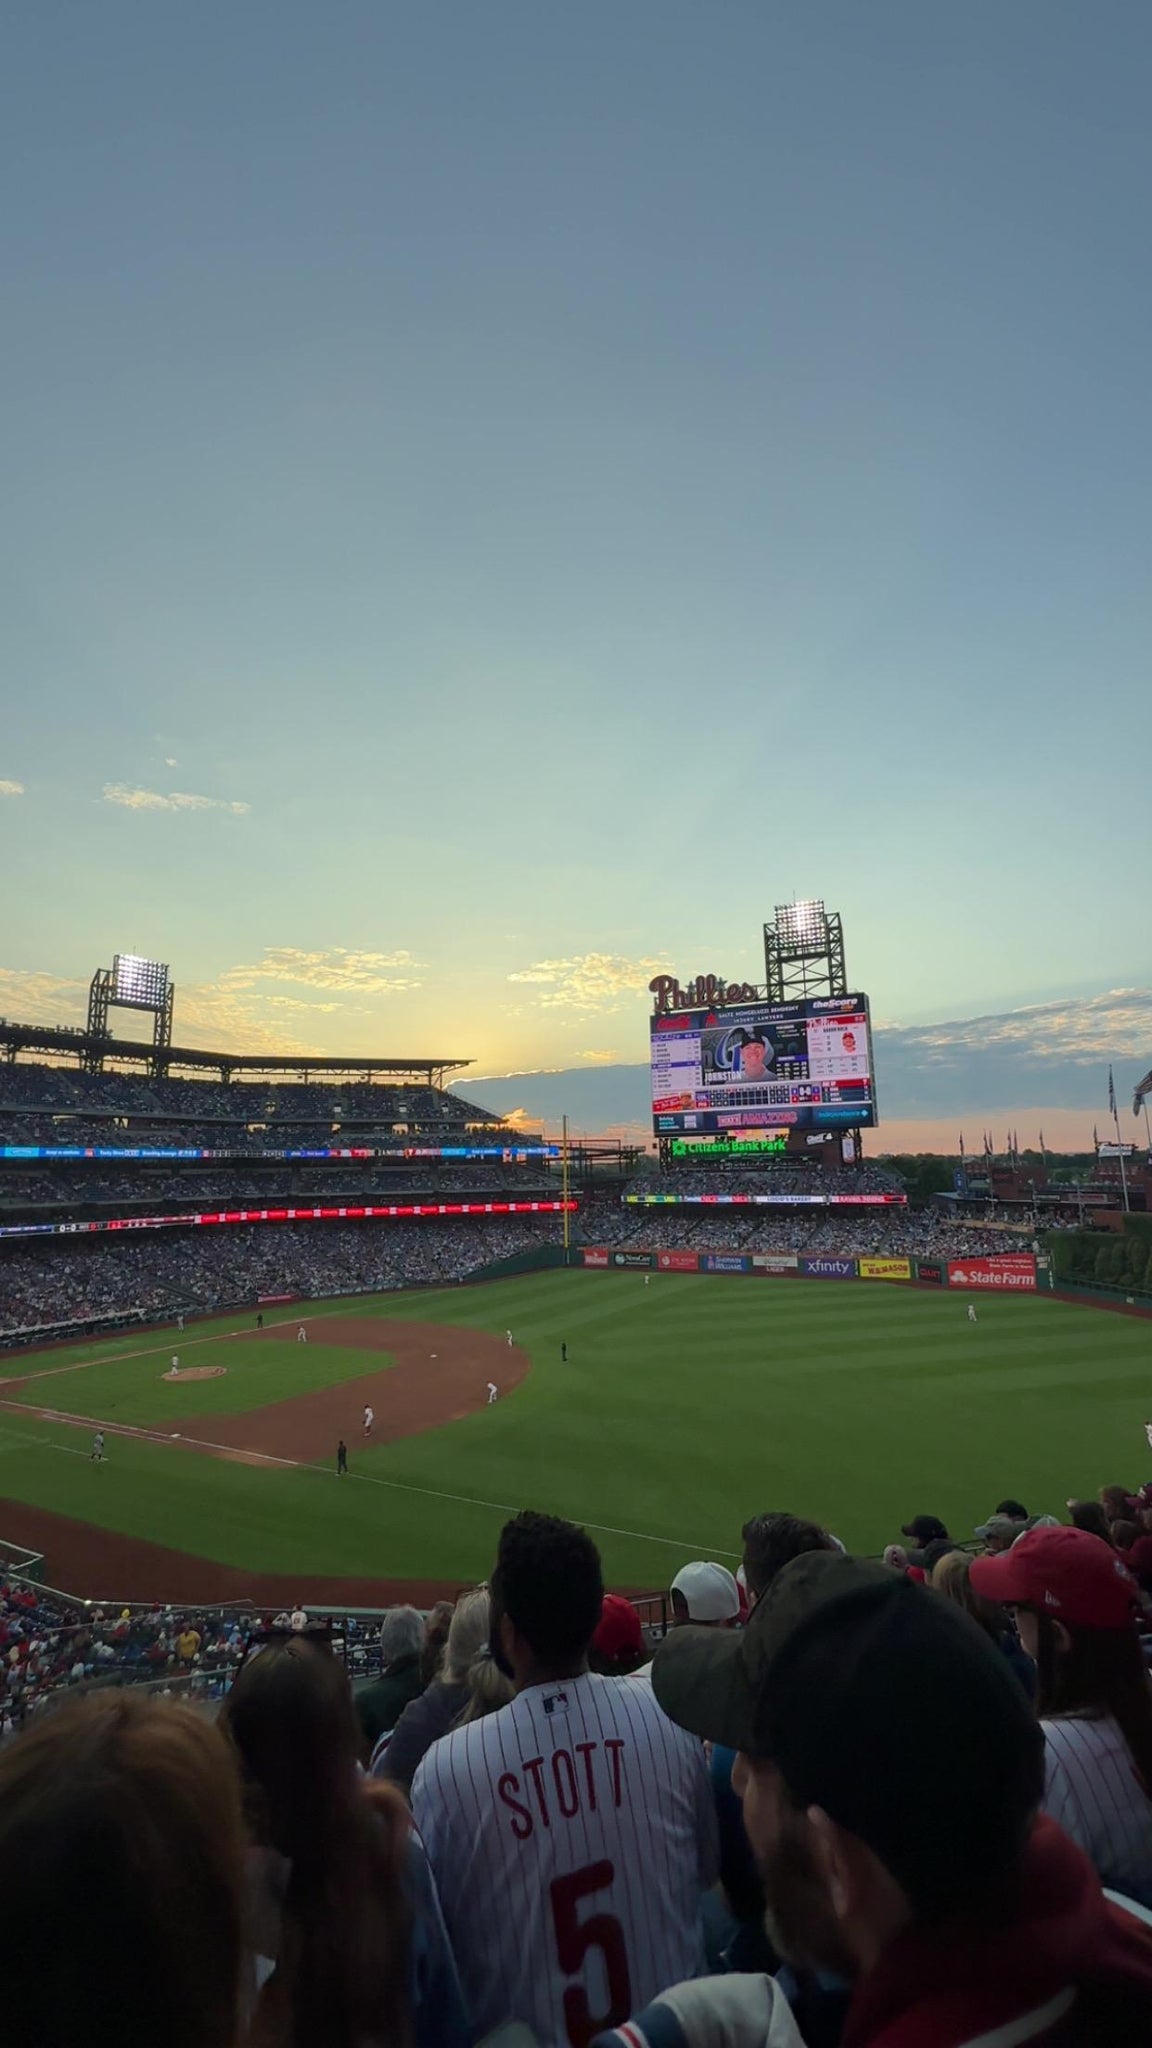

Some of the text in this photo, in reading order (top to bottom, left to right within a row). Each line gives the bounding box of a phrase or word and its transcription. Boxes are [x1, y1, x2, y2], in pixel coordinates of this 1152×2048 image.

[649, 974, 756, 1012] Phillies
[688, 1139, 786, 1153] Citizens Bank Park
[808, 1259, 849, 1274] xfinity
[499, 1739, 625, 1840] STOTT
[550, 1859, 632, 2048] 5
